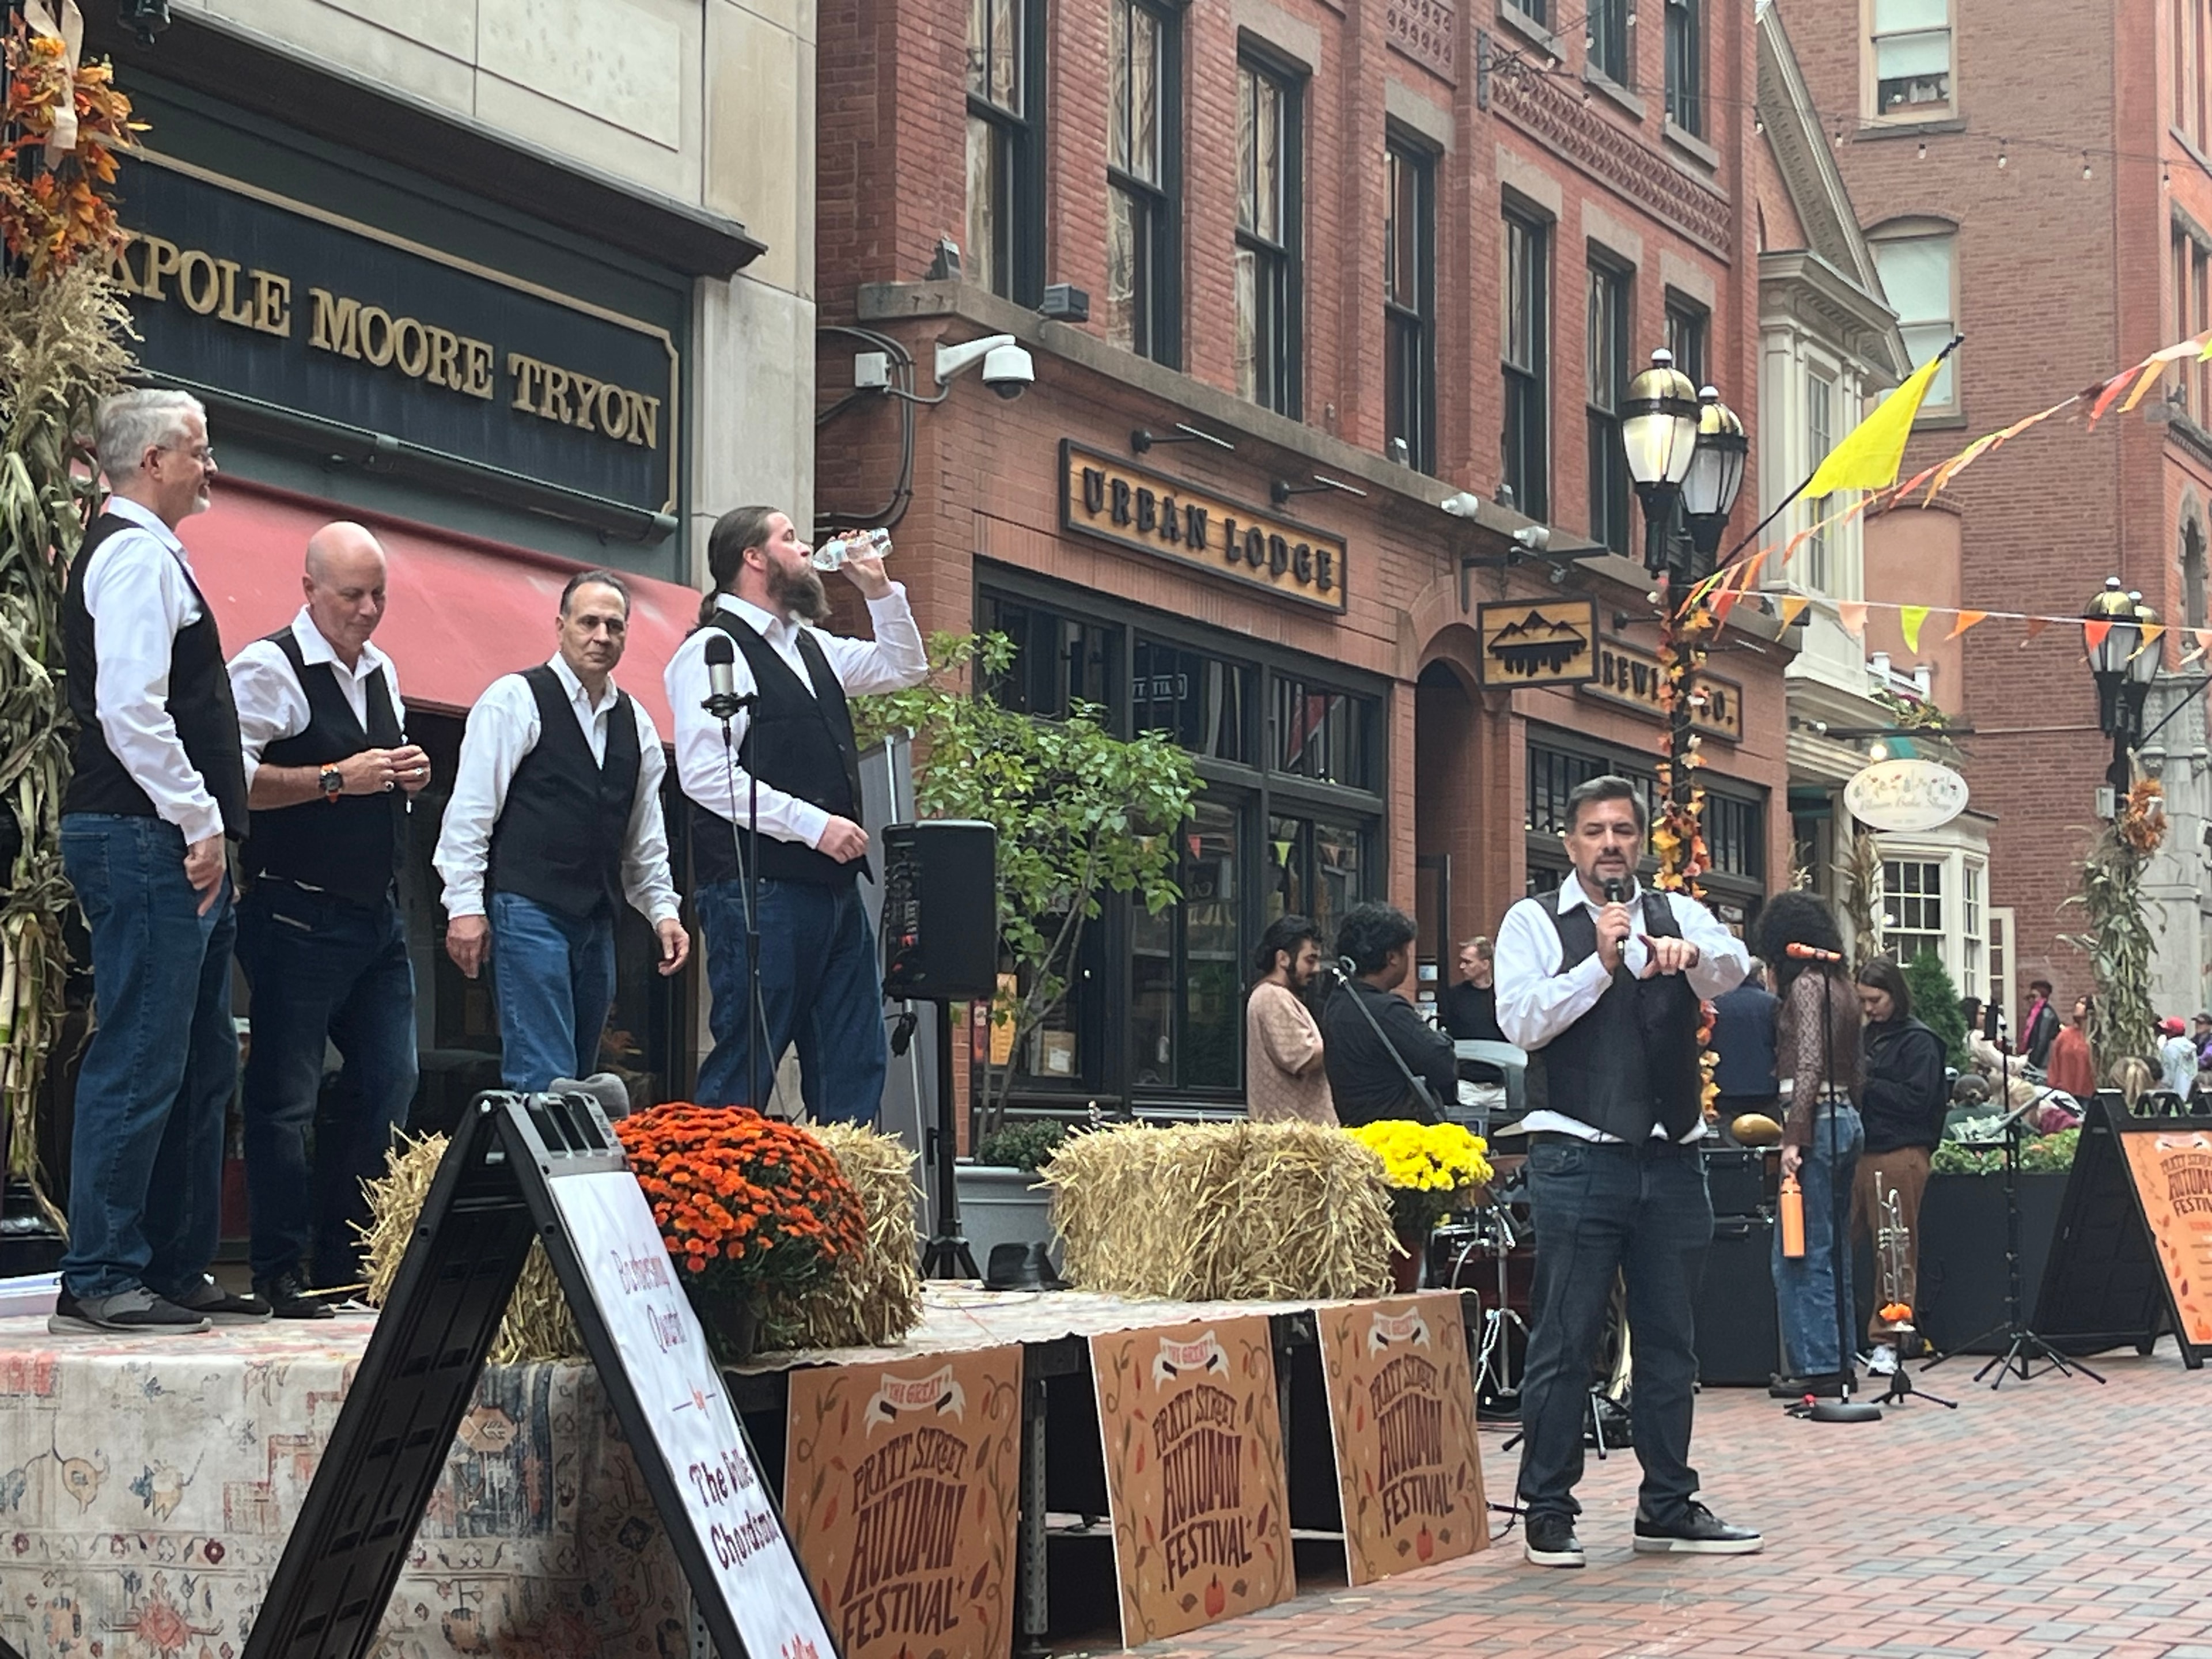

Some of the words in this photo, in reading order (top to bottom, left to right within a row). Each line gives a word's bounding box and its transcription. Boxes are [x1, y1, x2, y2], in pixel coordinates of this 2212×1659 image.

[104, 226, 290, 337] KPOLE
[309, 287, 494, 400] MOORE
[508, 352, 661, 449] TRYON
[1083, 465, 1207, 550] URBAN
[1225, 518, 1333, 590] LODGE
[1603, 650, 1658, 702] REWI
[889, 1383, 906, 1404] THE
[907, 1376, 942, 1404] GREAT
[1183, 1339, 1209, 1365] GREAT
[1369, 1357, 1402, 1420] PRATT
[1404, 1353, 1438, 1396] STREET
[1152, 1389, 1194, 1460] PRATT
[1195, 1382, 1237, 1431] STREET
[1378, 1392, 1442, 1492] AUTUMN
[690, 1461, 728, 1508] The
[851, 1432, 912, 1515] PRATT
[910, 1426, 968, 1480] STREET
[1160, 1427, 1242, 1541] AUTUMN
[1382, 1472, 1454, 1537] FESTIVAL
[839, 1476, 968, 1608] AUTUMN
[1165, 1515, 1252, 1592] FESTIVAL
[842, 1577, 959, 1659] FESTIVAL
